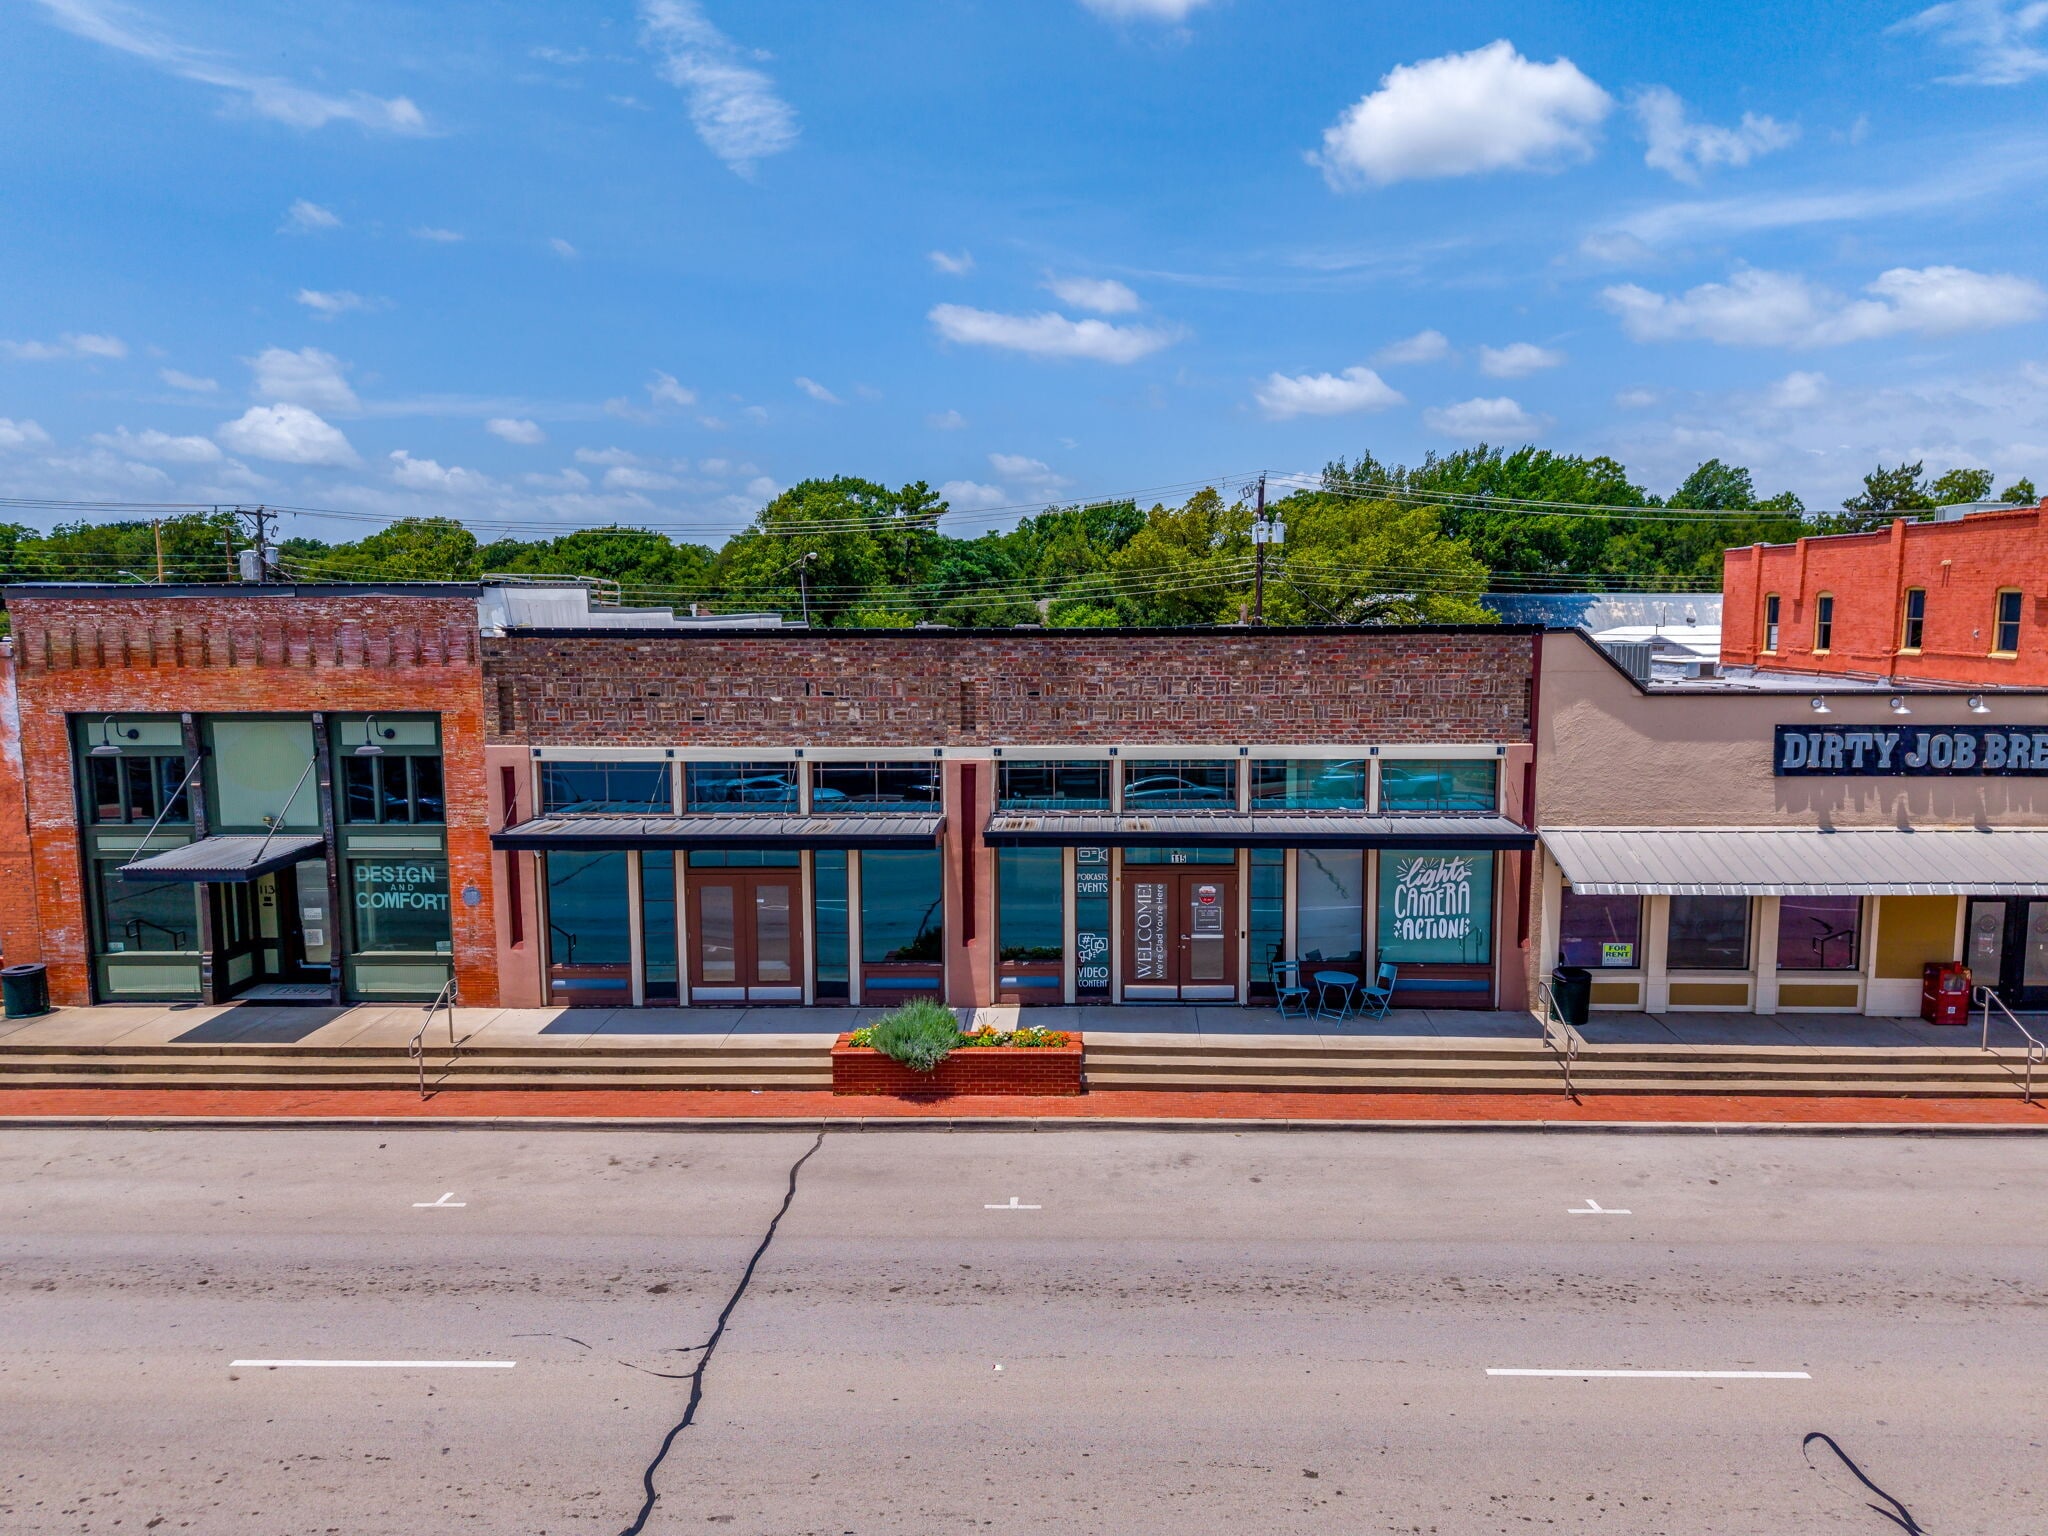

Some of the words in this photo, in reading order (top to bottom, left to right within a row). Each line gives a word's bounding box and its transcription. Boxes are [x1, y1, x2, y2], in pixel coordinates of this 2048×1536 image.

[1782, 732, 1901, 769] DIRTY
[1904, 732, 1978, 769] JOB
[1172, 855, 1185, 863] 115
[356, 866, 436, 883] DESIGN
[1077, 873, 1108, 881] PODCASTS
[260, 885, 275, 894] 113
[390, 883, 414, 891] AND
[1077, 882, 1108, 893] EVENTS
[1156, 883, 1164, 904] Here
[355, 891, 449, 911] COMFORT
[1394, 881, 1470, 918] CAMERA
[1156, 905, 1164, 932] You're
[1137, 884, 1152, 978] WELCOME!
[1156, 933, 1164, 953] Glad
[1078, 966, 1108, 978] VIDEO
[1156, 955, 1164, 979] We're
[1078, 979, 1108, 988] CONTENT
